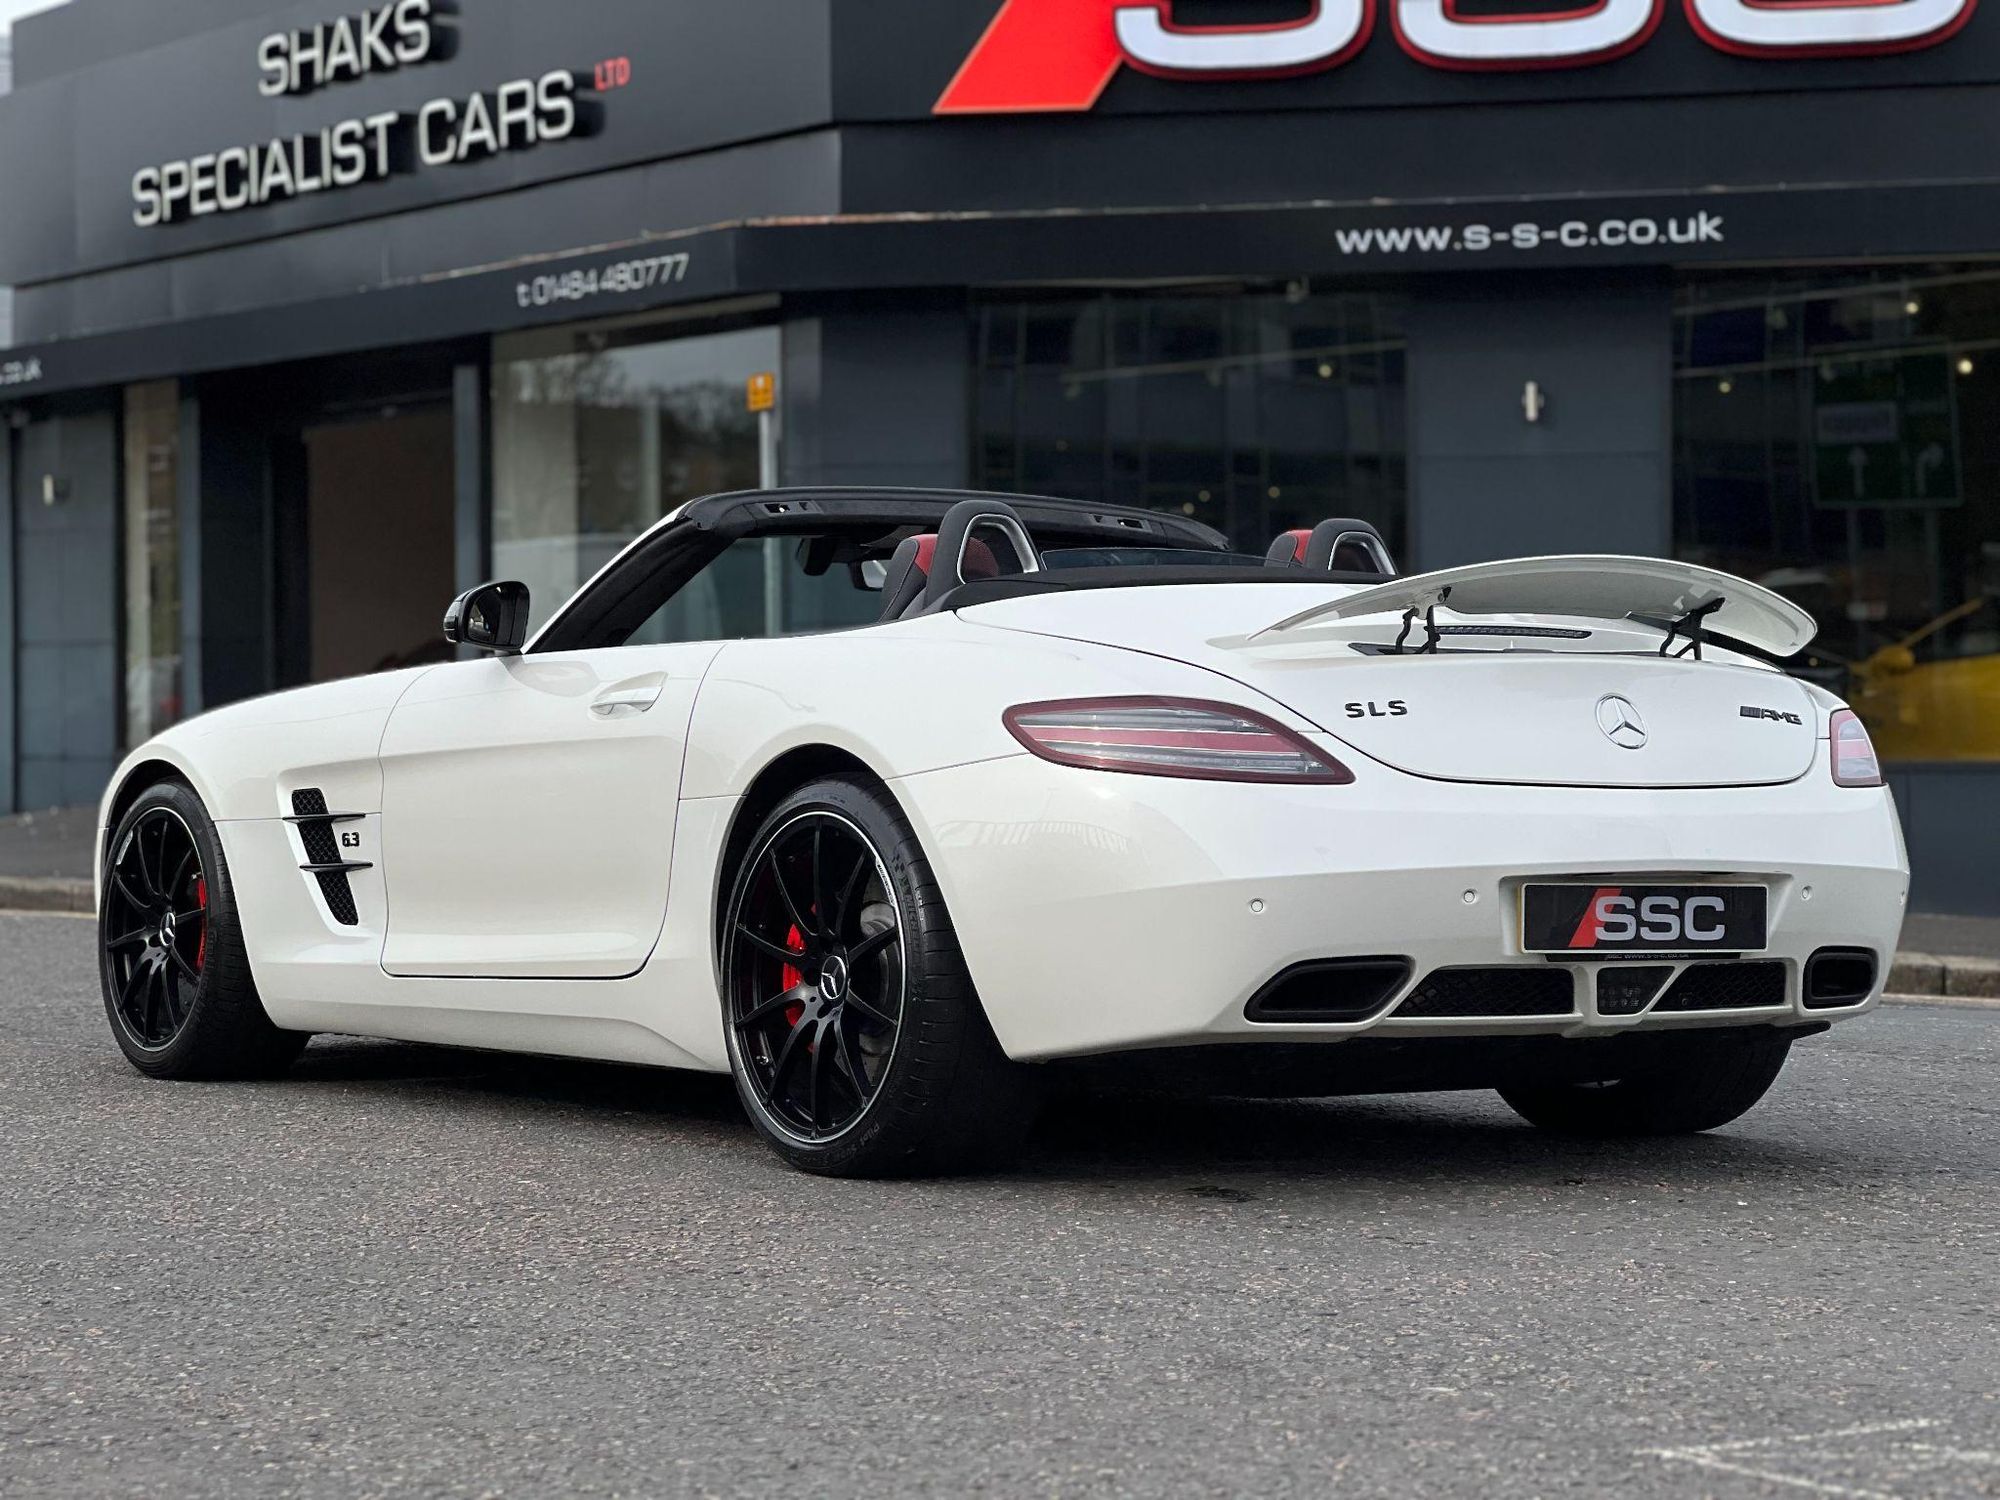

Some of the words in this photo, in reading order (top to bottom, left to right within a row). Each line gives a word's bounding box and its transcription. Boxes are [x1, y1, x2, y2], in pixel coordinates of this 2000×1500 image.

[258, 0, 431, 96] SHAKS
[132, 112, 398, 226] SPECIALIST
[418, 70, 574, 166] CARS
[594, 56, 631, 91] LTD
[1336, 211, 1724, 253] www.s-s-c.co.uk
[1344, 699, 1408, 718] SLS
[1761, 708, 1802, 725] AMG
[1594, 895, 1725, 941] SSC
